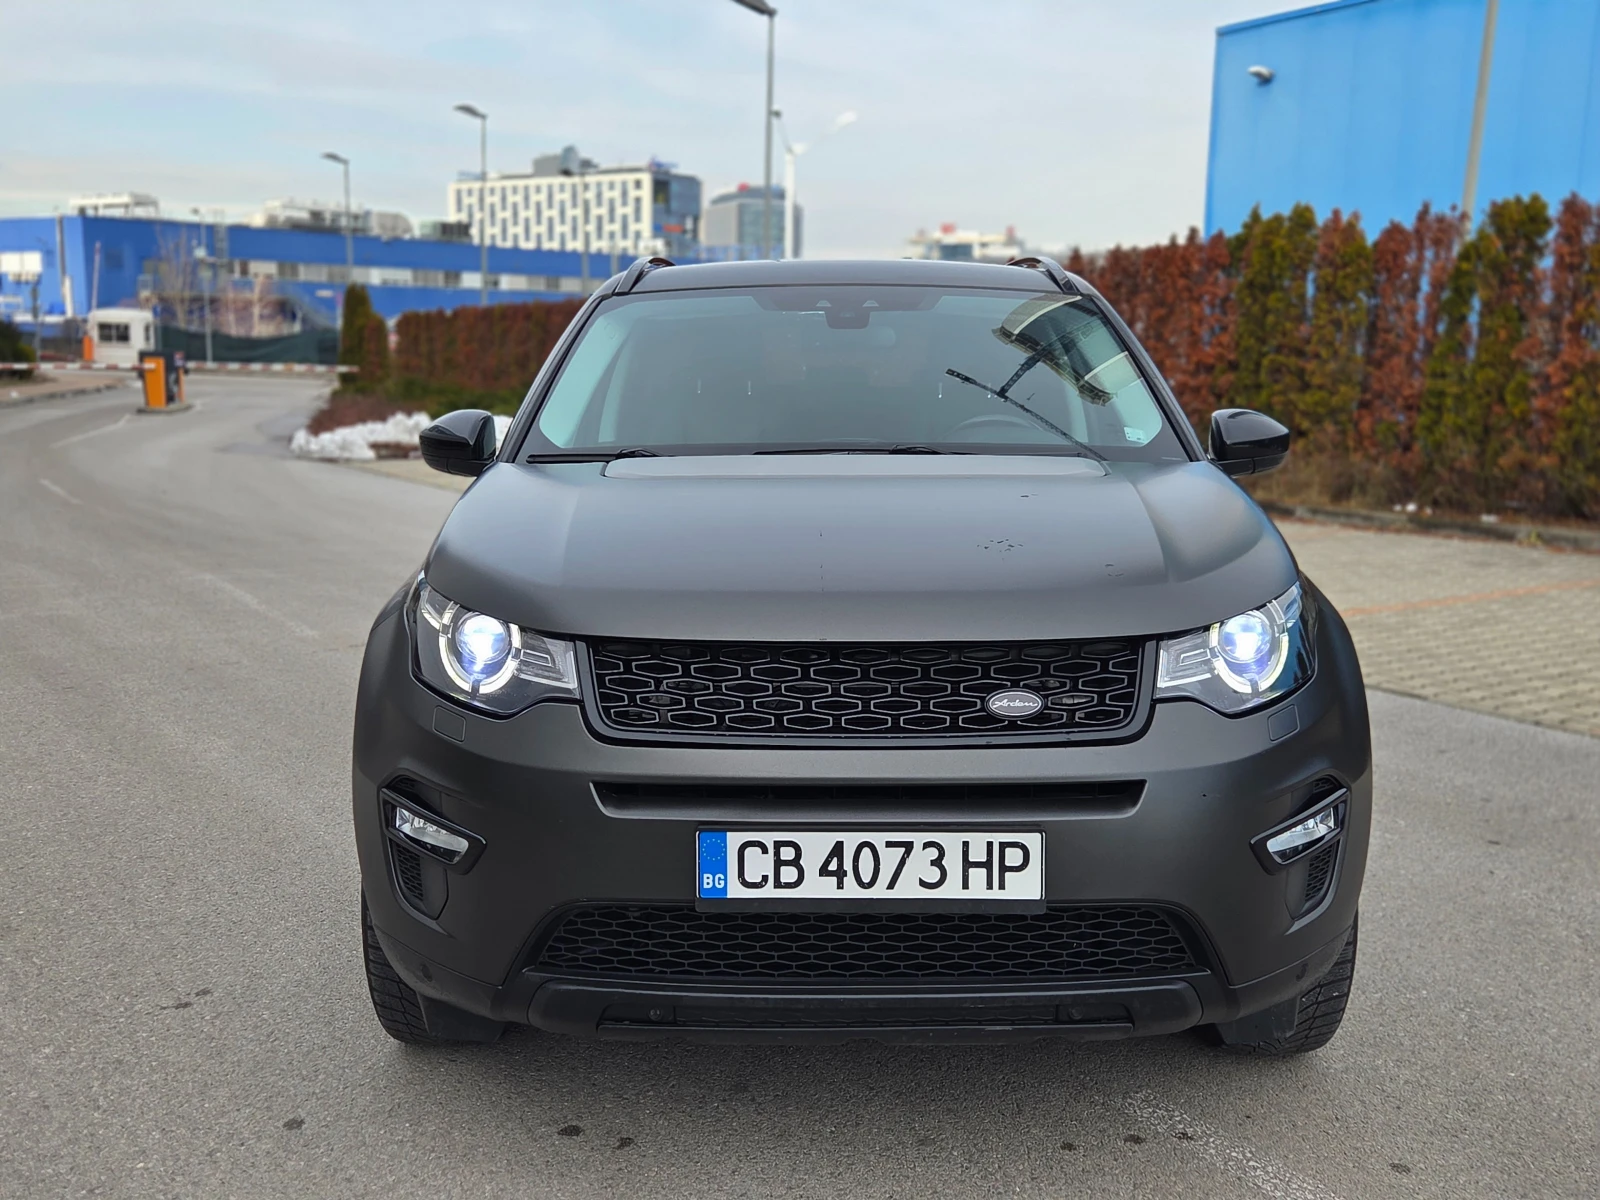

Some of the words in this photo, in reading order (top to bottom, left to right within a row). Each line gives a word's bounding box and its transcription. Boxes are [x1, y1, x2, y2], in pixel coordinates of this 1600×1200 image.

[703, 873, 725, 889] BG
[736, 840, 805, 890] CB
[818, 840, 948, 890] 4073
[961, 840, 1031, 890] HP
